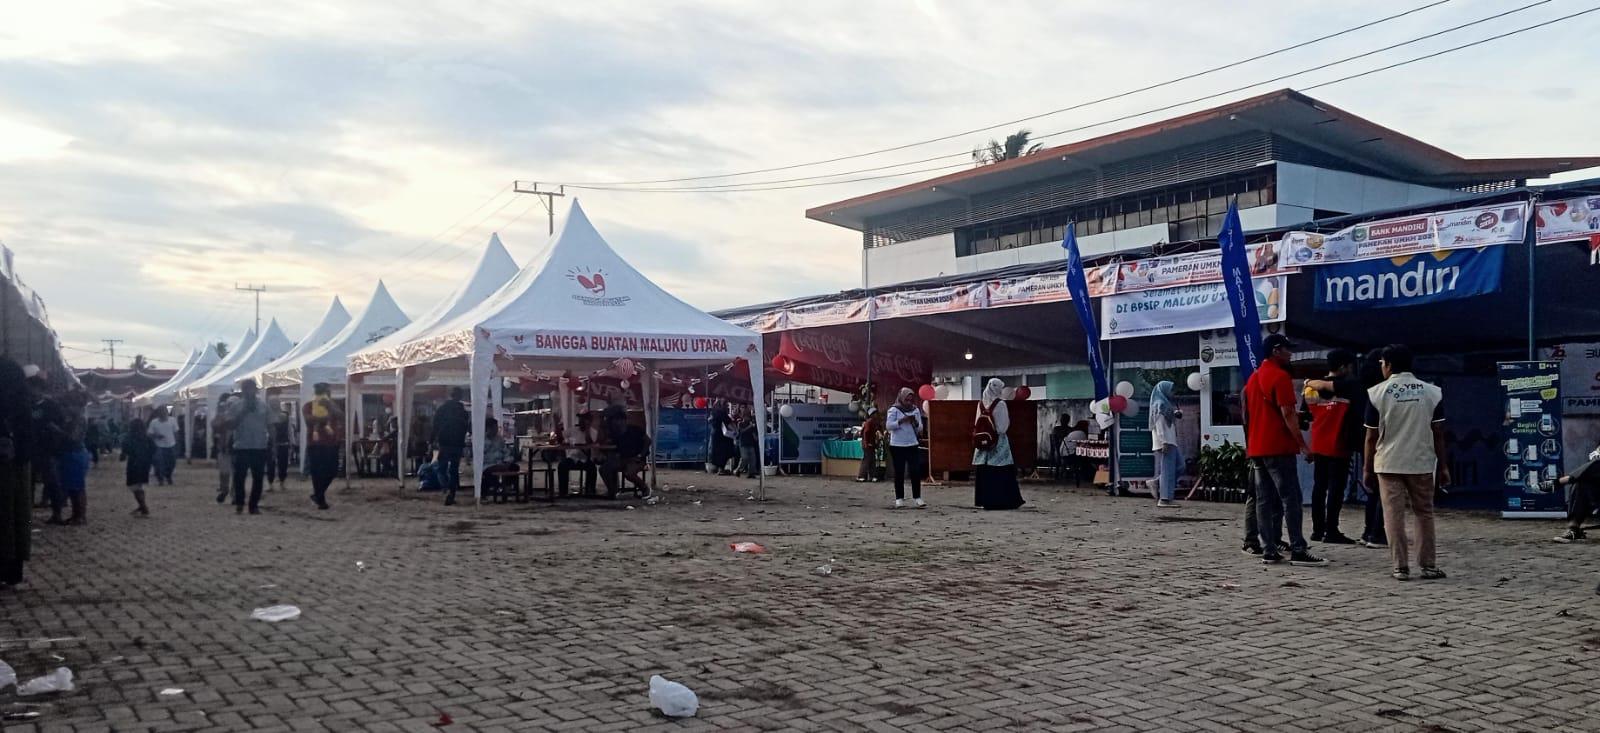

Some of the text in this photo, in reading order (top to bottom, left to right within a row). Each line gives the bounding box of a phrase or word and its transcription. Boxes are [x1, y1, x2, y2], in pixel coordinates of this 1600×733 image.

[1370, 222, 1426, 238] BANK MANDIRI
[1161, 263, 1199, 276] PAMERAN
[1325, 261, 1460, 302] mandiri
[1116, 303, 1128, 314] DI
[1131, 299, 1160, 313] BPSIP
[1162, 293, 1210, 309] MALUKU
[535, 334, 728, 353] BANGGA BUATAN MALUKU UTARA
